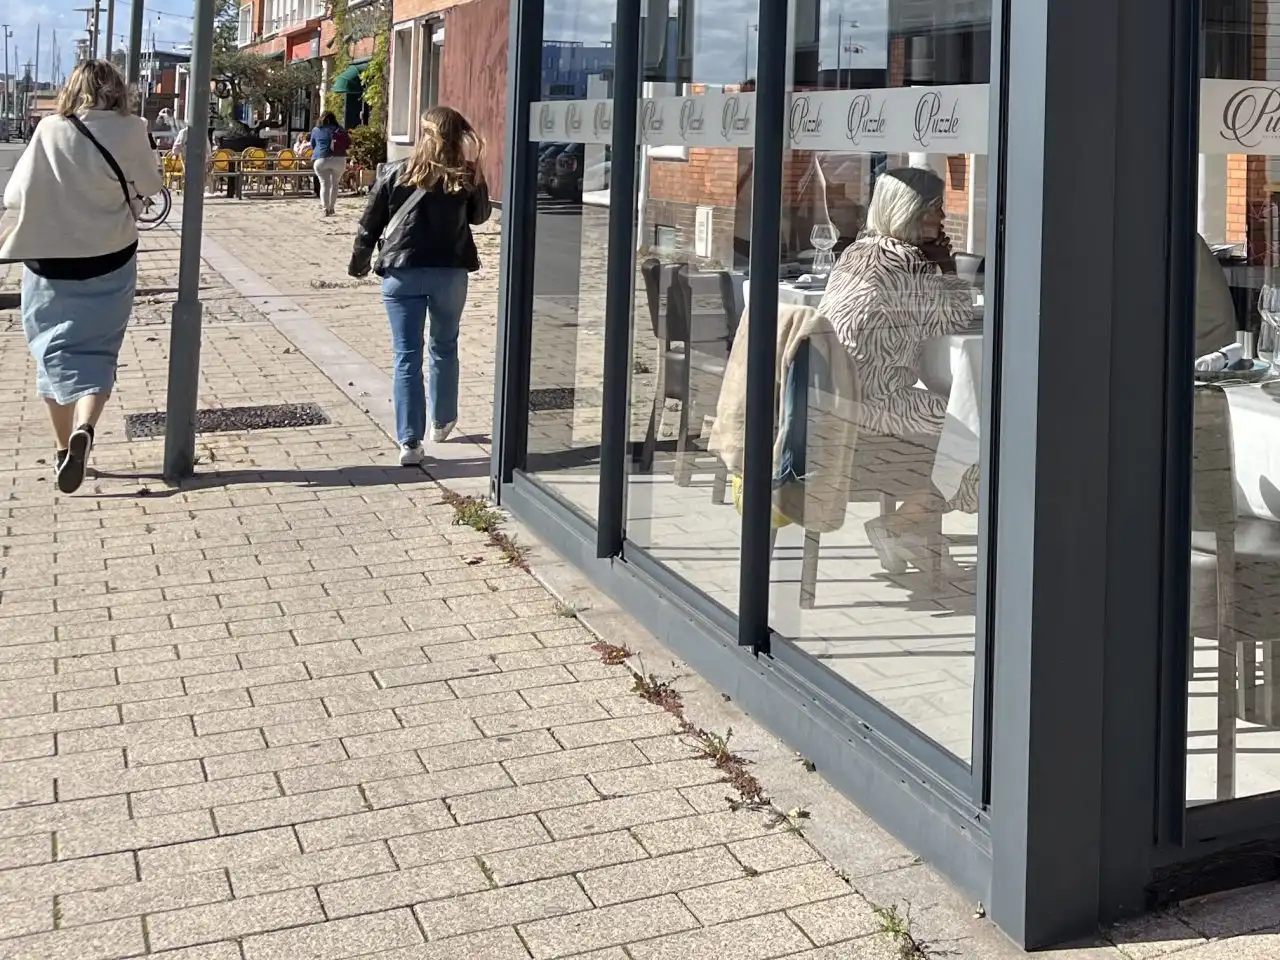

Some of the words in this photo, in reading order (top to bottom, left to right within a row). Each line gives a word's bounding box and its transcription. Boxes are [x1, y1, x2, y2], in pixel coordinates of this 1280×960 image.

[789, 96, 823, 145] Puzzle
[846, 93, 887, 146] Puzzle
[913, 91, 959, 147] Puzzle
